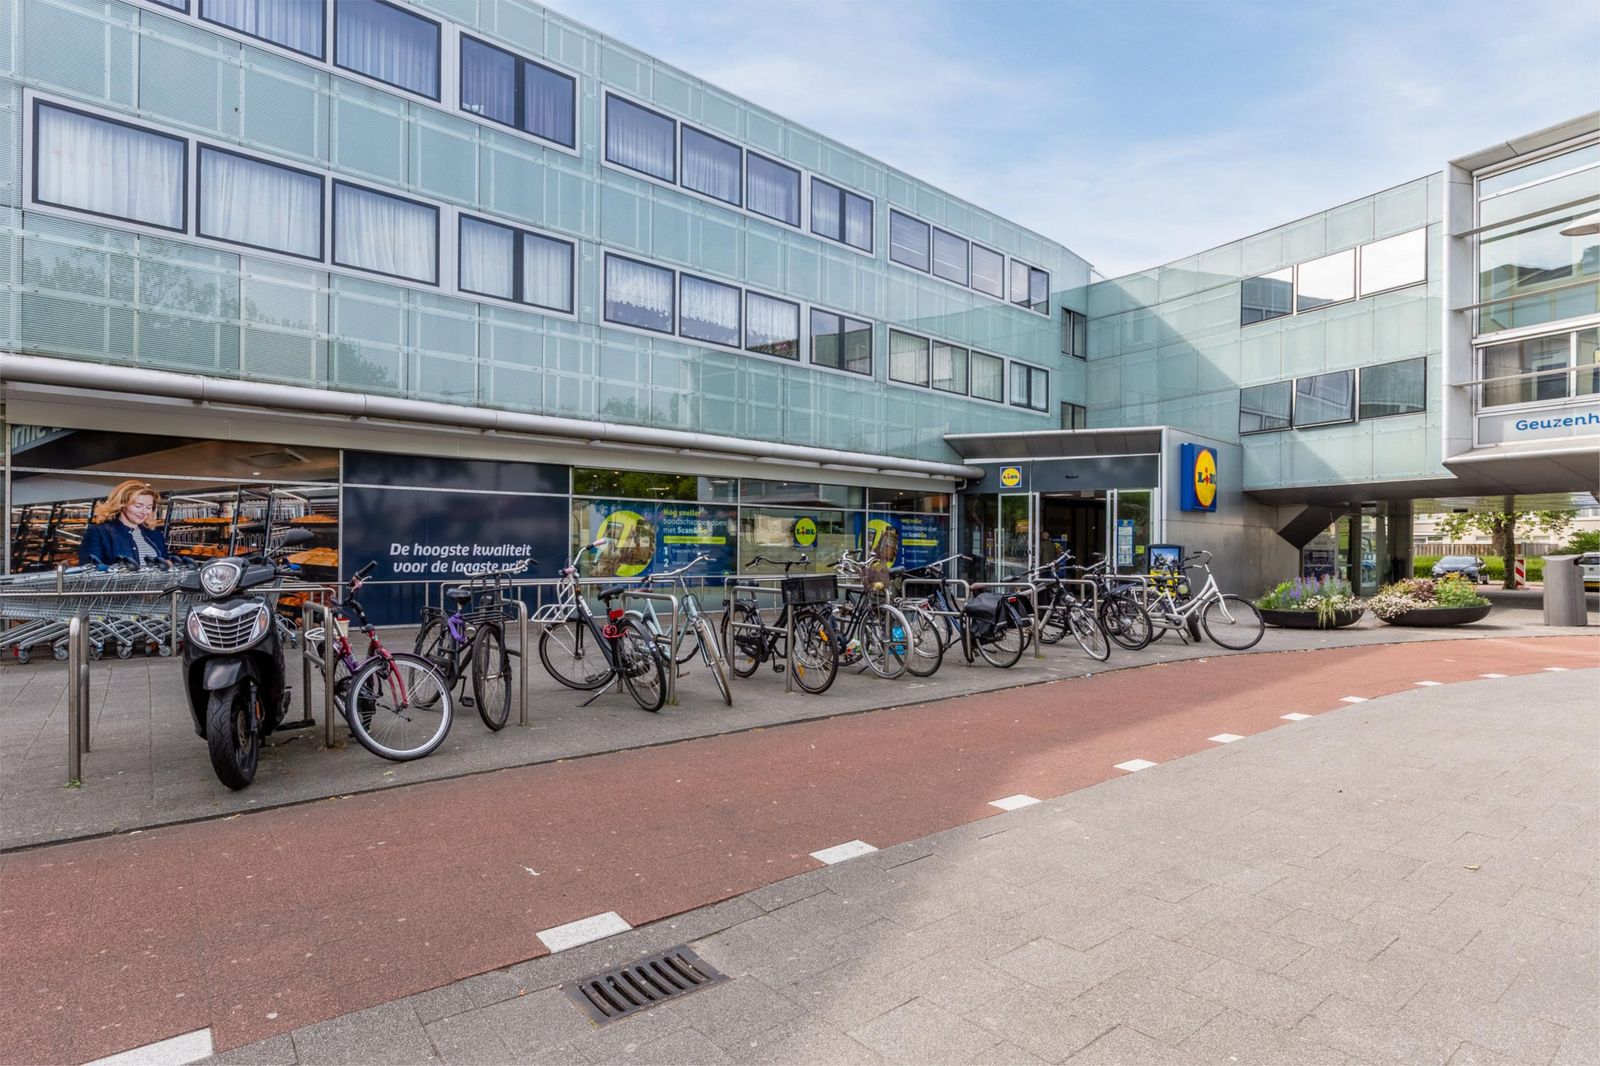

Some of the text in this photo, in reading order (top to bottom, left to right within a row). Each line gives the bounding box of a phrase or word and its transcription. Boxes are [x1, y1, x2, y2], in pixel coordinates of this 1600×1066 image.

[1516, 413, 1600, 431] Geuzenh
[390, 543, 532, 558] De hoogste kwaliteit
[393, 562, 428, 573] voor
[431, 560, 448, 573] de
[451, 560, 499, 574] laagste
